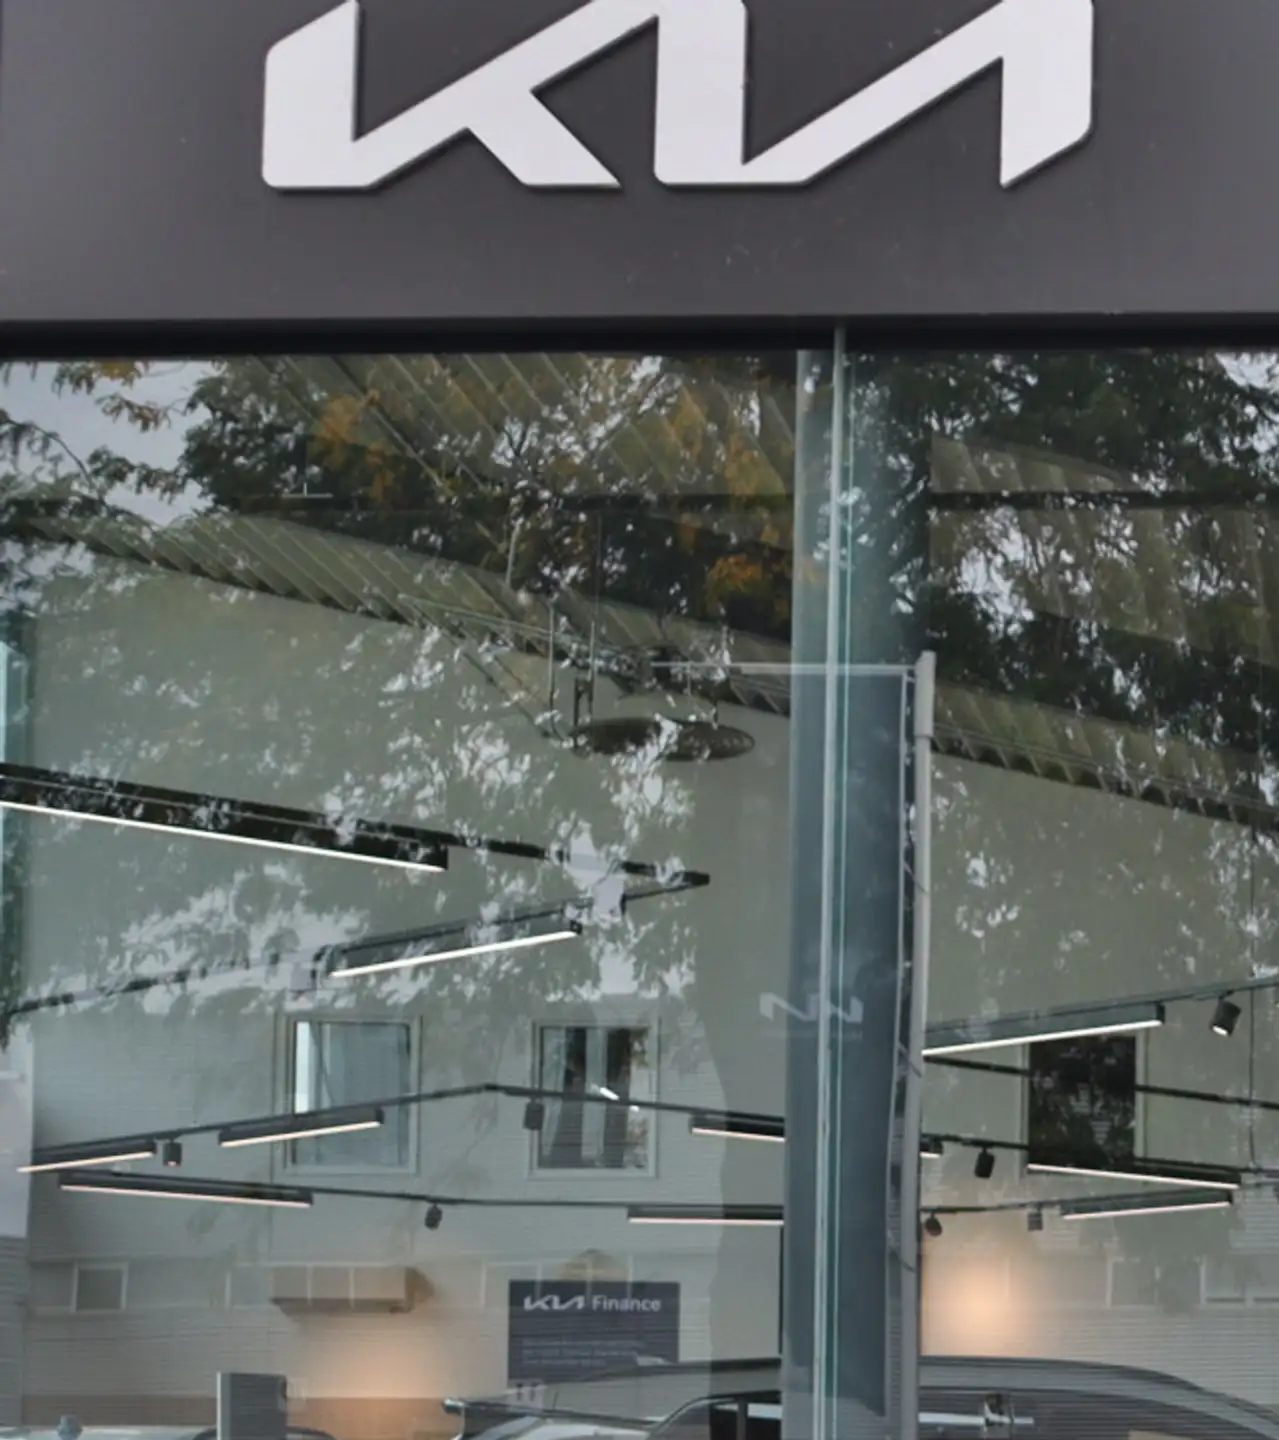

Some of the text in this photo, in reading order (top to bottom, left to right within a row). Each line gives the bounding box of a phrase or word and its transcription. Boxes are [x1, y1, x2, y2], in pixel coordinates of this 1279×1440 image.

[261, 0, 1094, 189] KIA
[523, 1295, 661, 1312] KIA Finance
